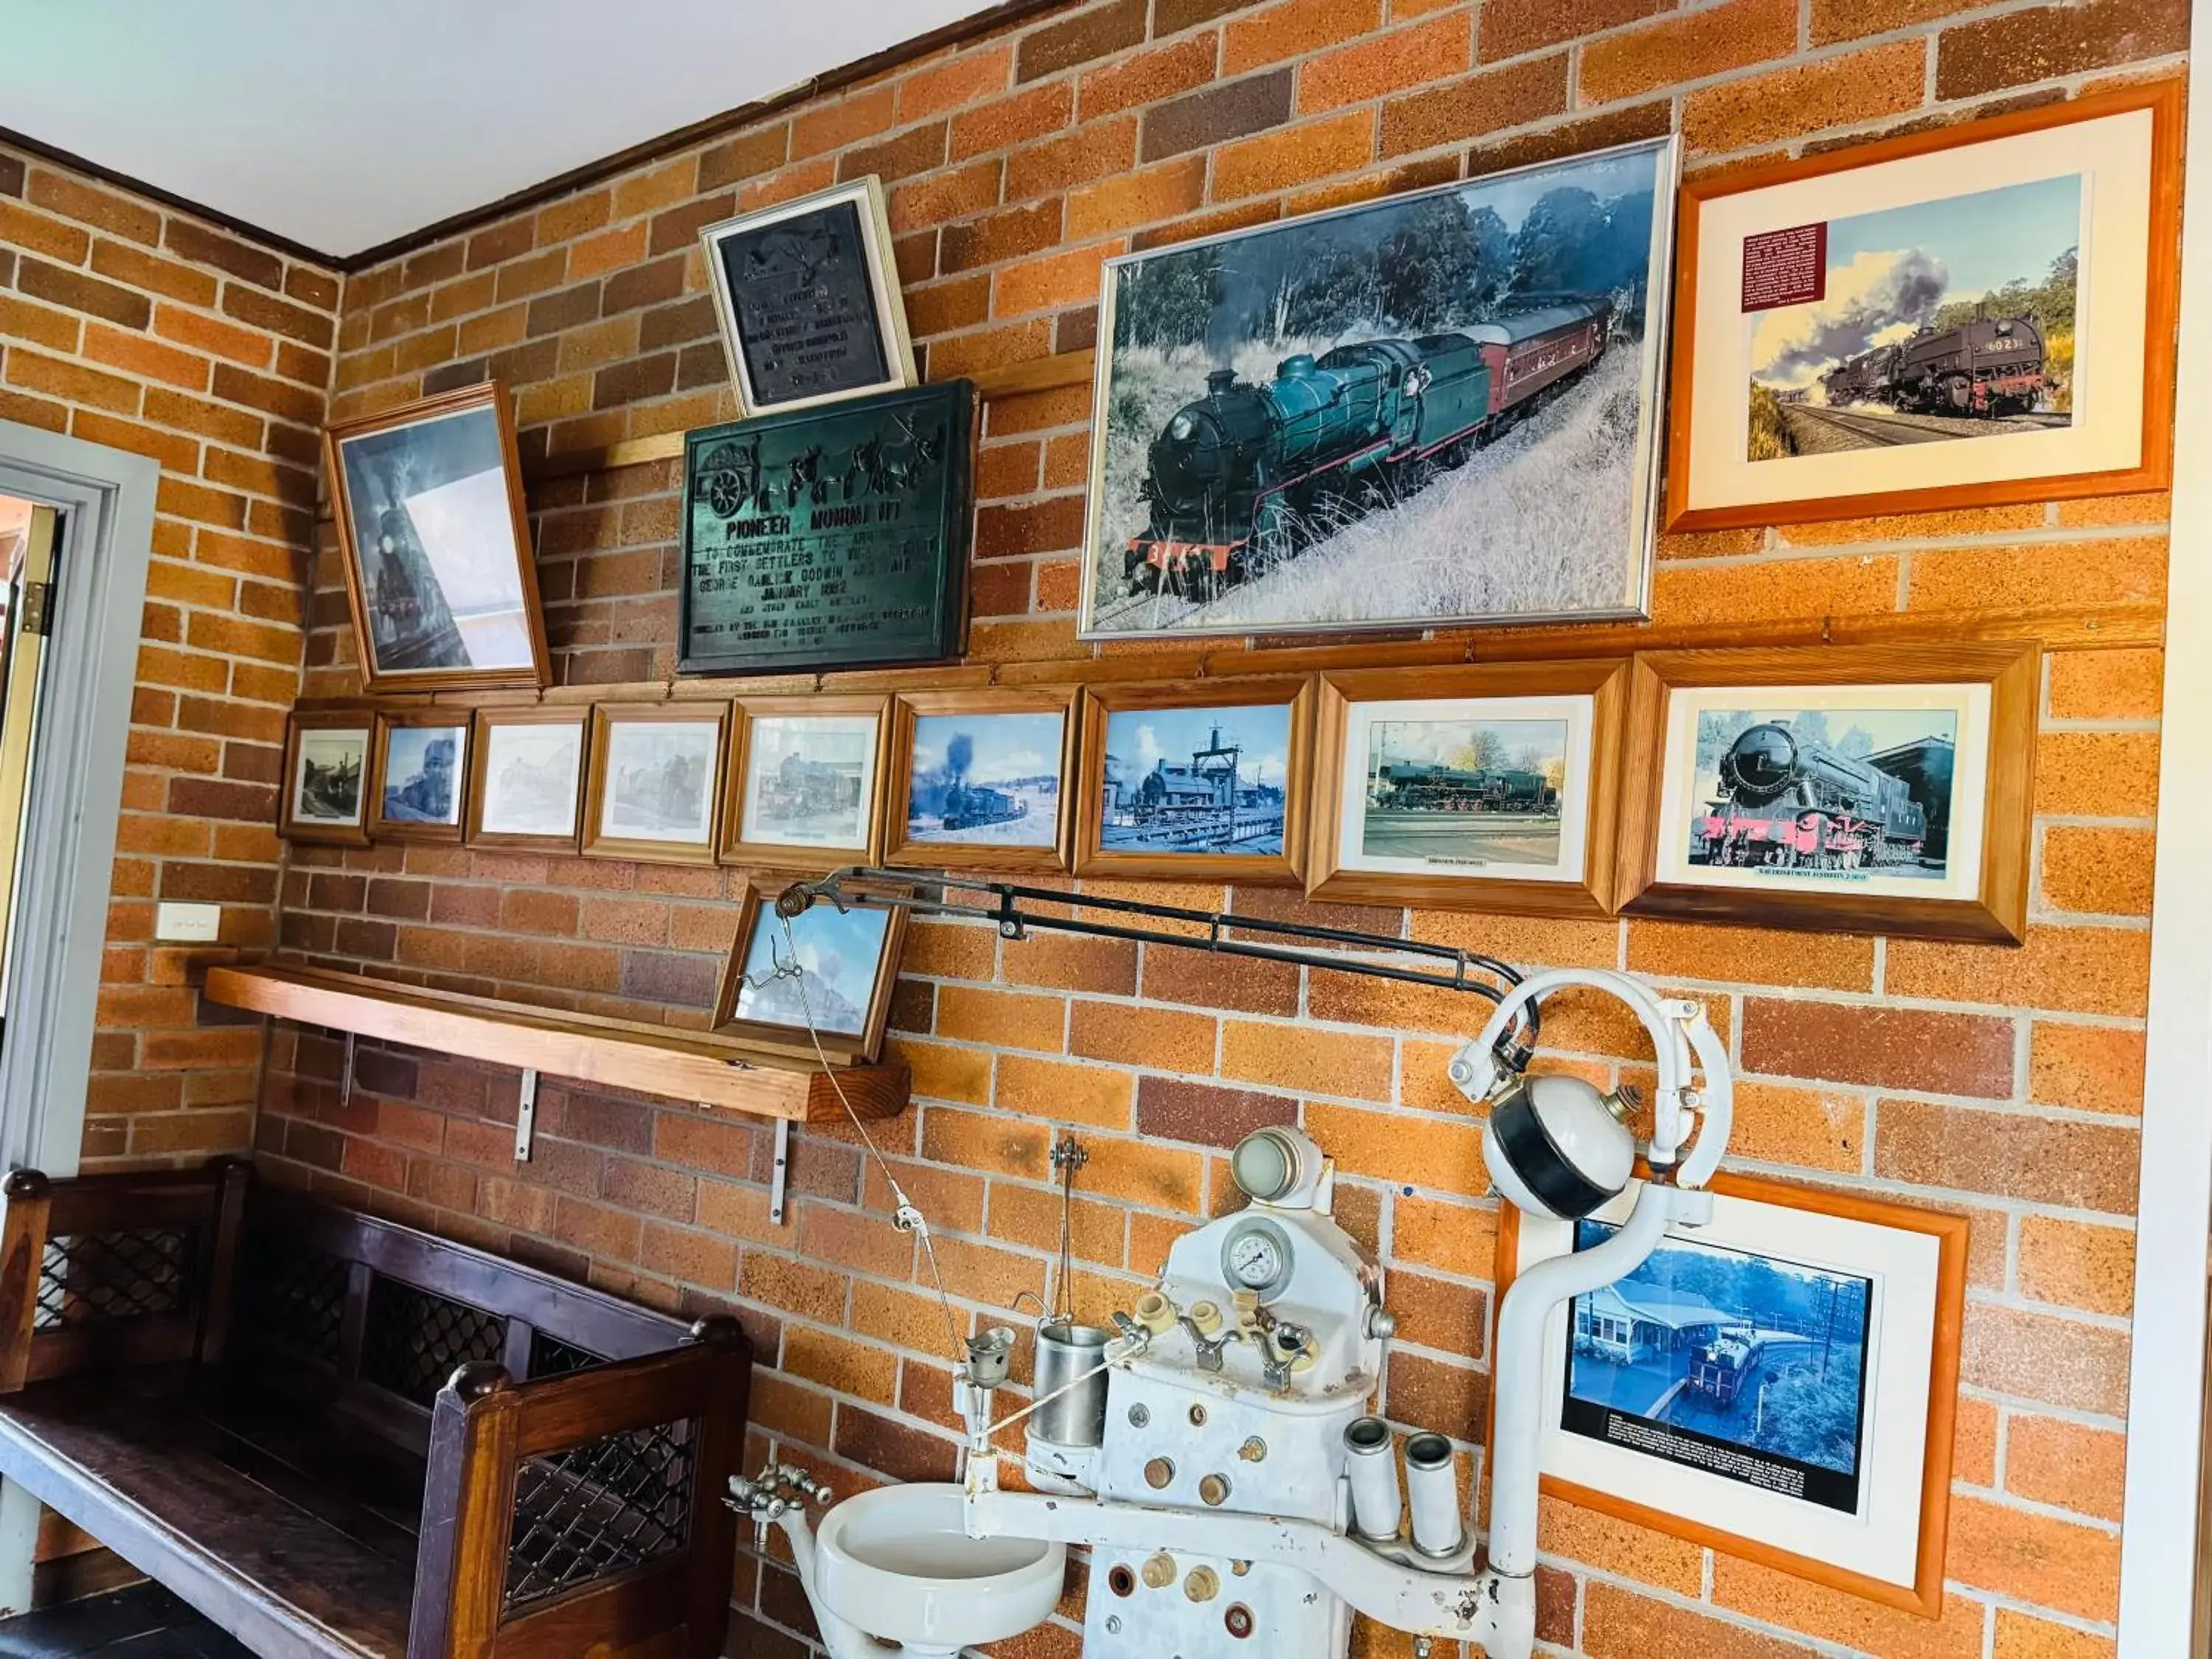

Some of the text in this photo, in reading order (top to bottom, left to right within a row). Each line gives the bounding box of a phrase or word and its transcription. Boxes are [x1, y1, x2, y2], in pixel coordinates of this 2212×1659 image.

[726, 515, 790, 540] PIONEER
[726, 538, 805, 558] COMMEMORATE
[818, 533, 838, 549] THE
[692, 563, 711, 577] THE
[718, 559, 748, 574] FIRST
[756, 552, 813, 570] SETTLERS
